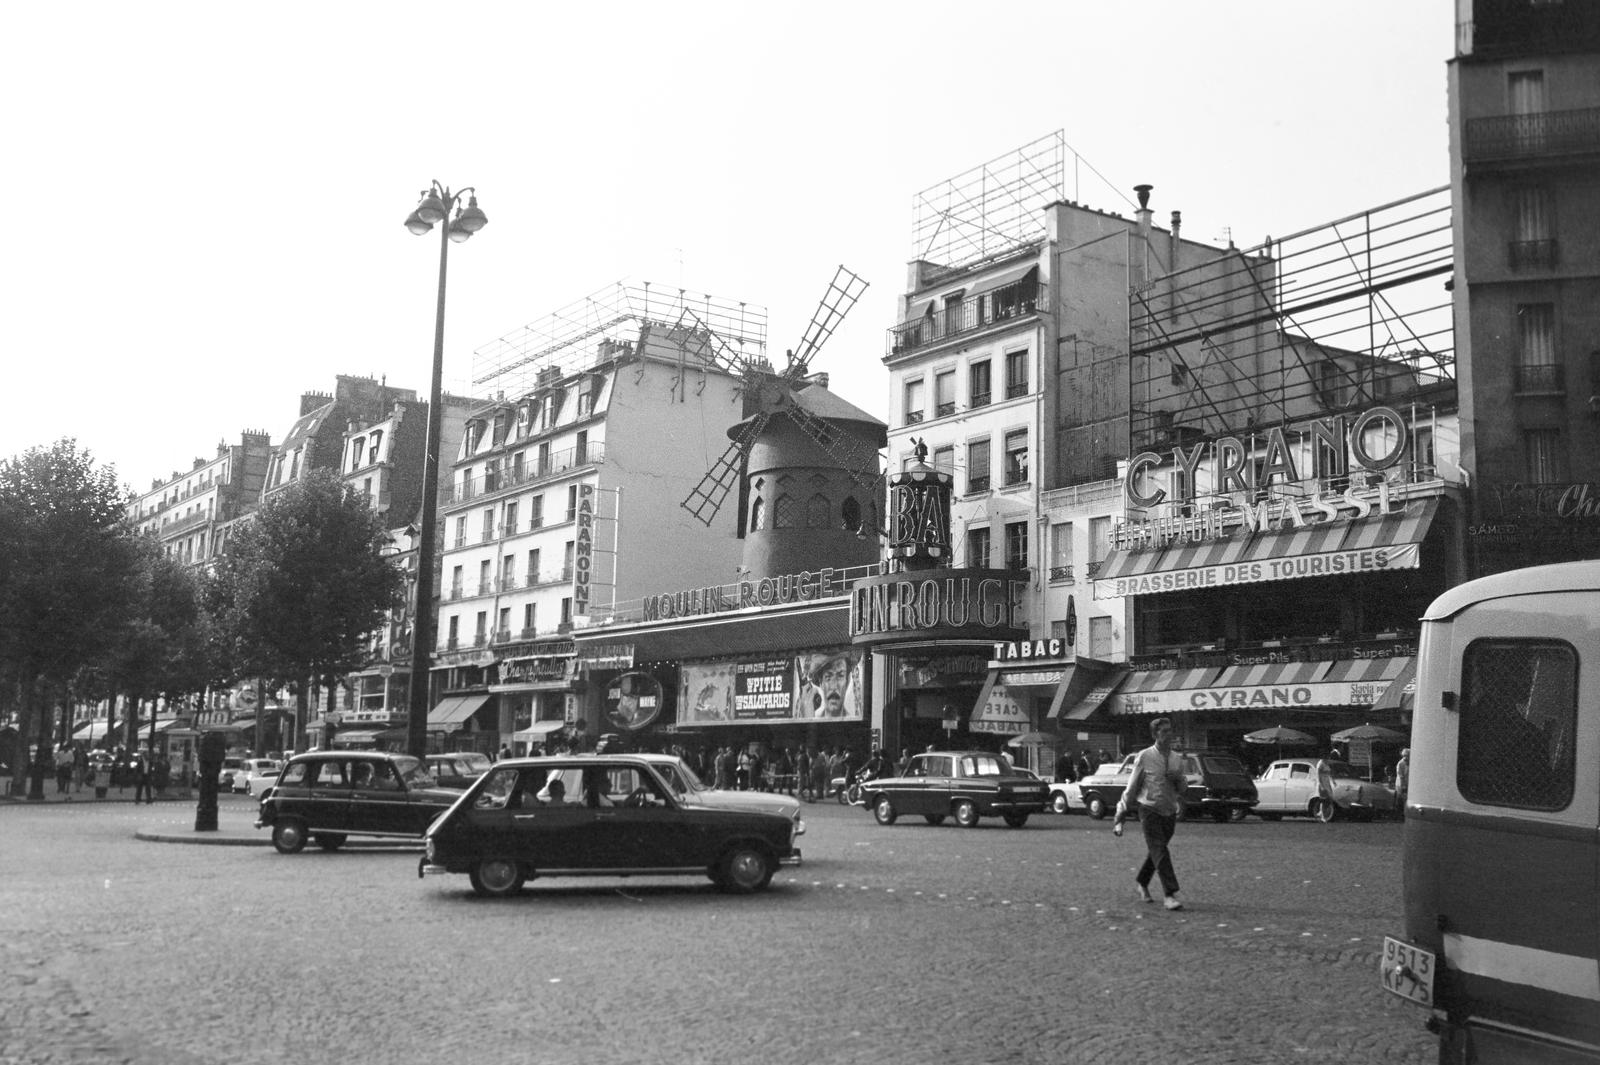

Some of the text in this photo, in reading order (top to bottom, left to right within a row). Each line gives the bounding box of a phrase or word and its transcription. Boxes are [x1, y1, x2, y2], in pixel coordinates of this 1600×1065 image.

[1125, 405, 1411, 508] CYRANO
[1240, 480, 1408, 533] MASSE
[576, 484, 593, 615] PARAMOUNT
[1116, 549, 1391, 596] BRASSERIE DES TOURISTES
[643, 567, 834, 622] MOULIN ROUGE
[897, 577, 1029, 631] ROUGE
[994, 638, 1061, 659] TABAC
[1233, 651, 1290, 665] Super Pils
[1353, 647, 1394, 659] Super
[743, 692, 790, 710] SALOPARDS
[1190, 687, 1312, 708] CYRANO
[1388, 942, 1430, 975] 9513
